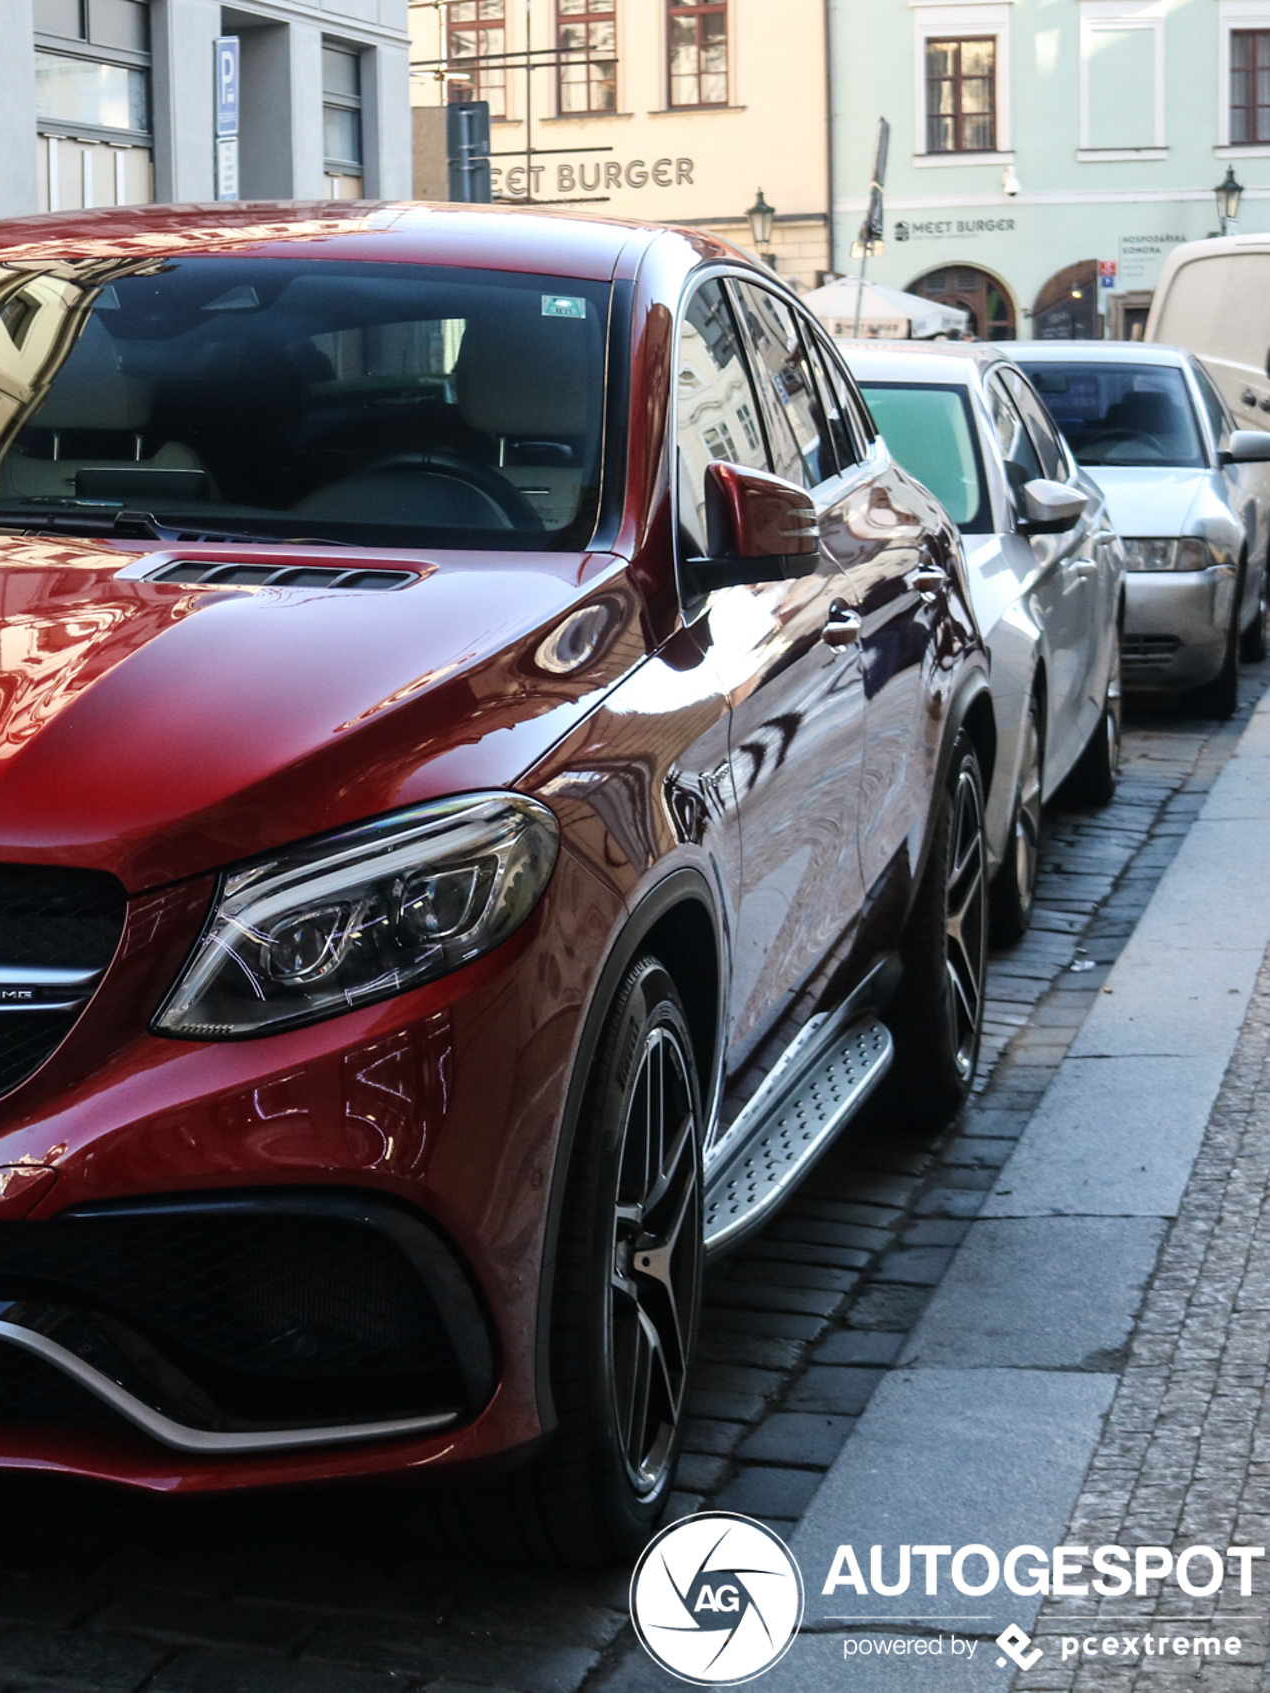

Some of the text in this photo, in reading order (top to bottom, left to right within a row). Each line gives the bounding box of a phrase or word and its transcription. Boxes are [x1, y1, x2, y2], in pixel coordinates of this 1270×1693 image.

[491, 158, 694, 194] EET BURGER
[912, 219, 1015, 234] MEET BURGER
